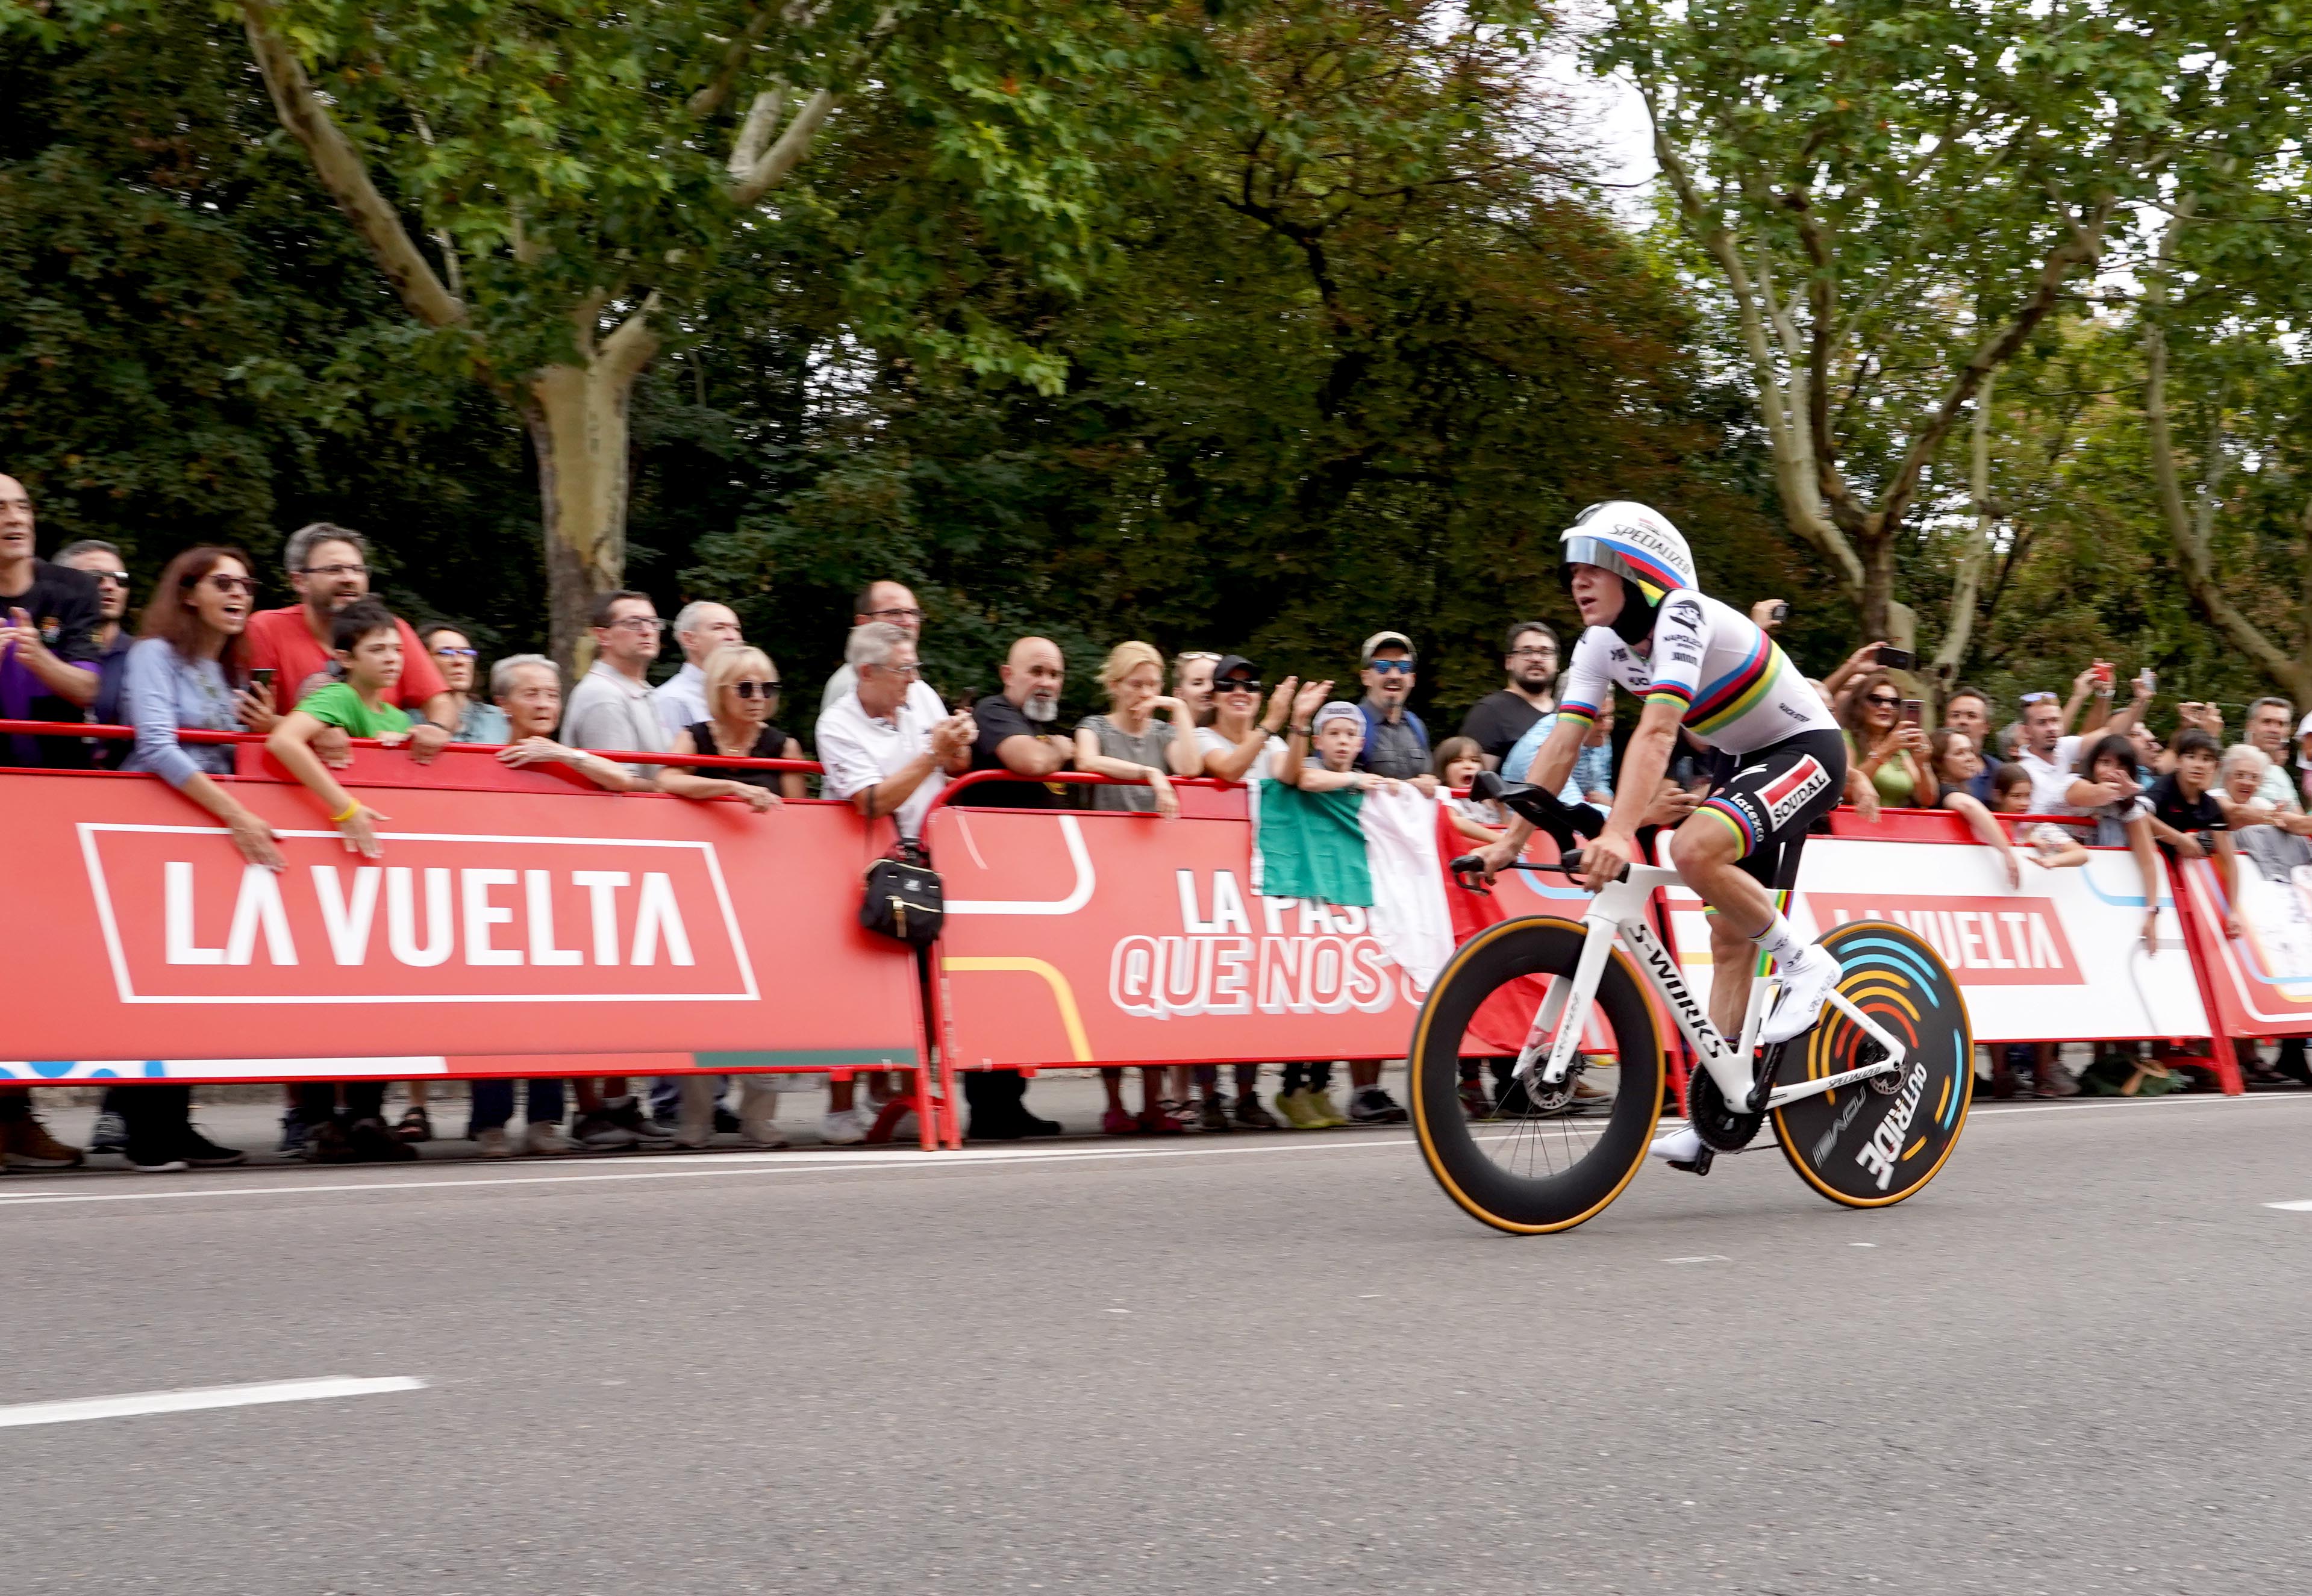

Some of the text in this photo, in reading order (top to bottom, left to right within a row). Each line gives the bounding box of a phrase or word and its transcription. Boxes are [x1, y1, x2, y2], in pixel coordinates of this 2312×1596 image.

[1607, 524, 1692, 574] SPECIALIZED
[1729, 792, 1765, 842] latexco
[1773, 774, 1826, 824] SOUDAL
[164, 861, 696, 967] LA VUELTA
[1176, 868, 1370, 934] LA PAS
[1109, 935, 1256, 1021] QUE
[1257, 936, 1396, 1014] NOS
[1628, 924, 1729, 1059] S-WORKS
[1826, 1067, 1882, 1089] SPECIALIZED
[1855, 1062, 1928, 1191] OUTRIDE
